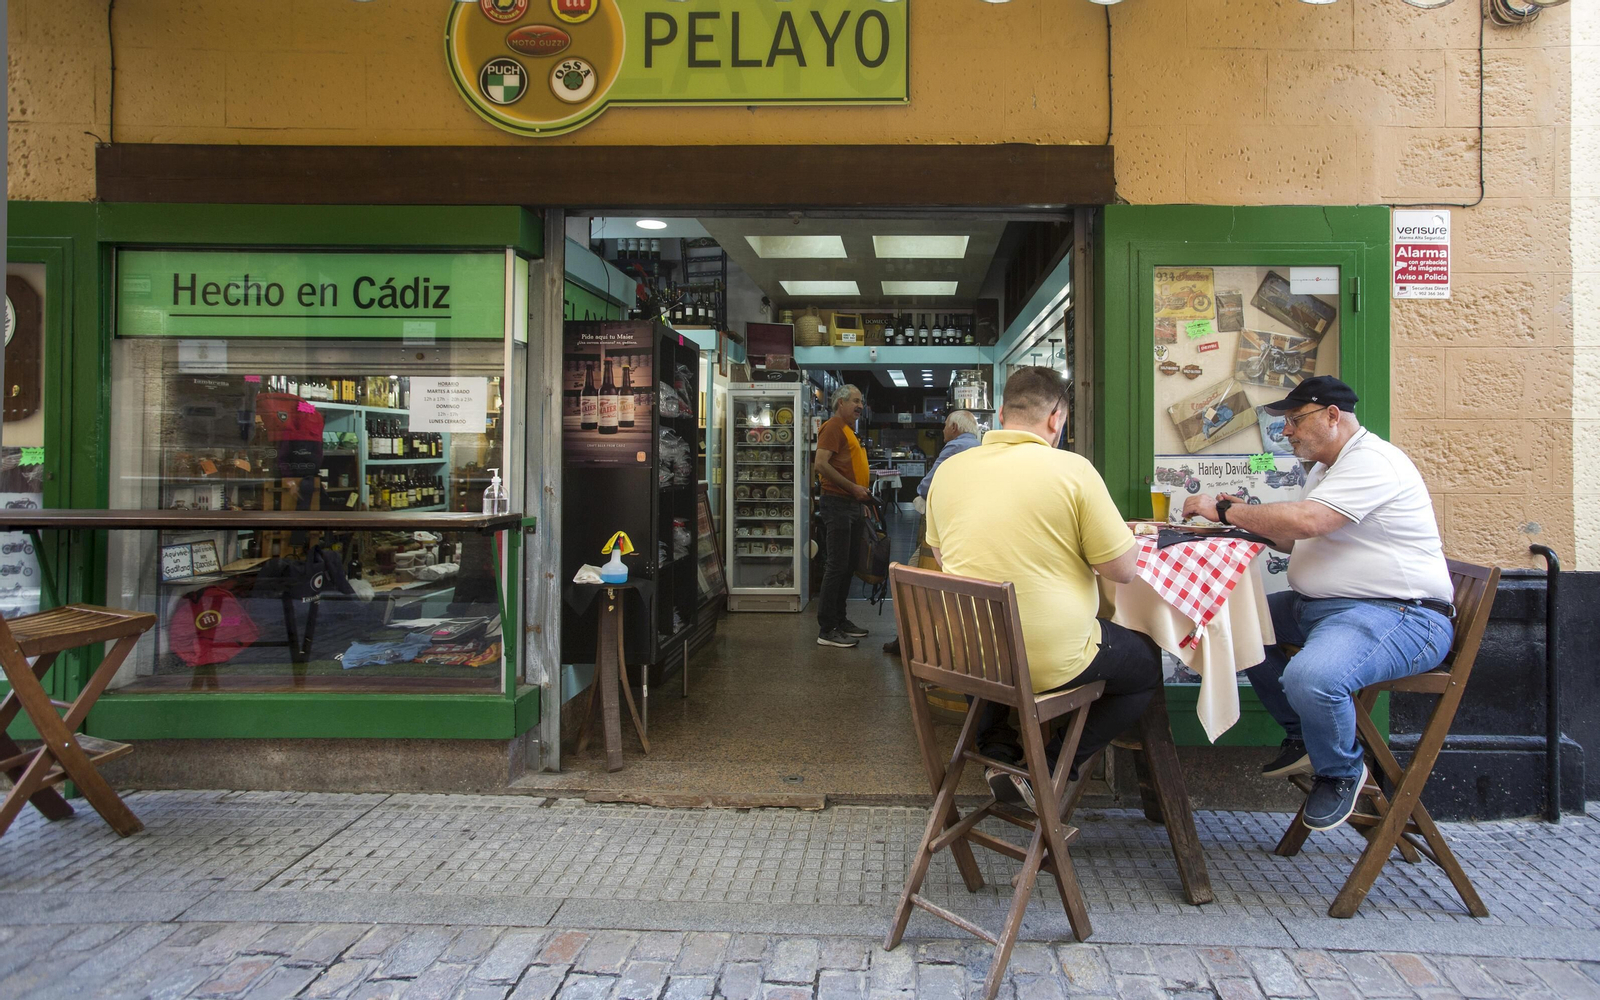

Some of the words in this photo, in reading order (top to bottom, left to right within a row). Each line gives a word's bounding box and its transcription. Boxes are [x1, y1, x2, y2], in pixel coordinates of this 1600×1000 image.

[512, 39, 536, 47] MOTO
[539, 39, 565, 47] GUZZI
[644, 9, 890, 69] PELAYO
[487, 65, 520, 75] PUCH
[555, 61, 591, 80] OSSA
[1396, 226, 1447, 235] verisure
[1396, 246, 1447, 258] Alarma
[1418, 265, 1447, 273] imágenes
[173, 273, 284, 307] Hecho
[297, 282, 338, 307] en
[352, 275, 450, 309] Cádiz
[595, 333, 608, 341] aquí
[1198, 462, 1223, 478] Harley
